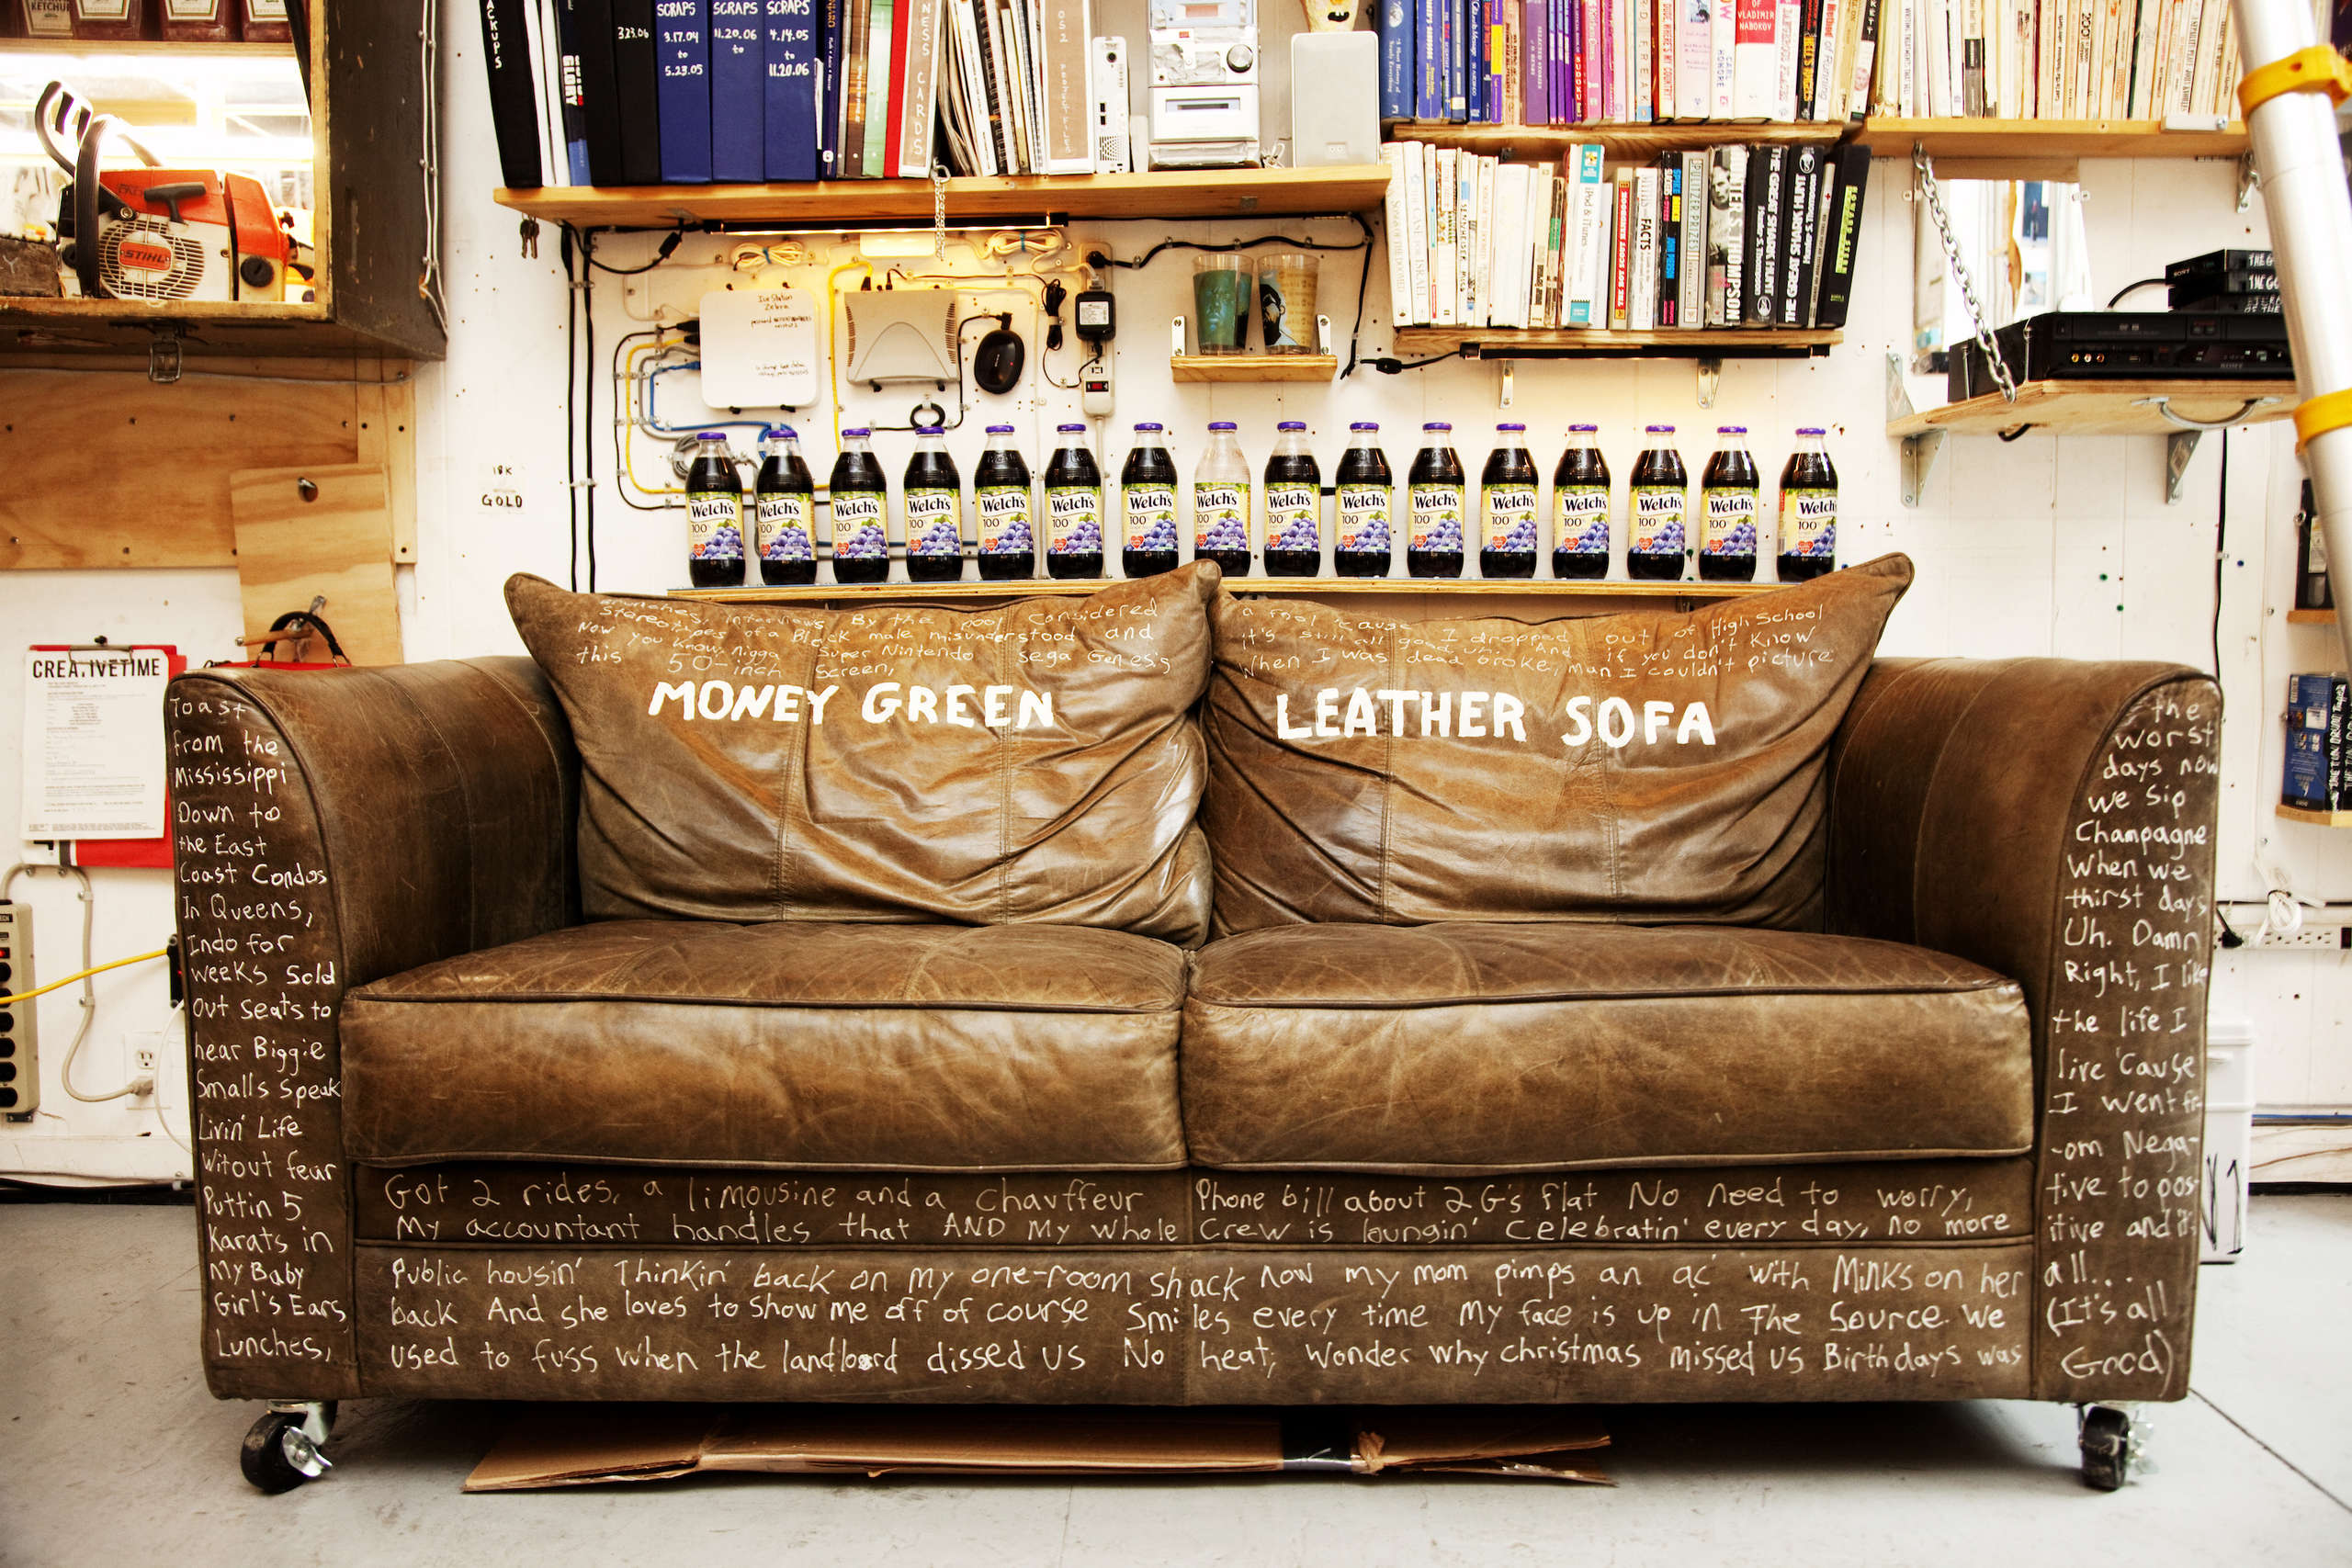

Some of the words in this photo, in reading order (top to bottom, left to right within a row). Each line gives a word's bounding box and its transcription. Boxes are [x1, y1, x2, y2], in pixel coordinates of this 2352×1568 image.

[656, 2, 696, 17] SCRAPS
[713, 1, 759, 16] SCRAPS
[766, 0, 810, 16] SCRAPS
[1739, 22, 1772, 31] NABOKOV
[677, 50, 689, 60] to
[784, 51, 796, 61] to
[1640, 219, 1651, 251] FACTS
[1726, 235, 1743, 321] THOMPSON
[481, 494, 523, 507] GOLD
[691, 501, 735, 518] Welch's
[835, 499, 878, 516] Welch's
[983, 494, 1026, 513] Welch's
[1129, 491, 1173, 511] Welch's
[1196, 491, 1238, 509] Welch's
[1342, 492, 1385, 510] Welch's
[1493, 493, 1536, 511] Welch's
[1565, 494, 1608, 513] Welch's
[1638, 494, 1682, 512] Welch's
[1710, 494, 1754, 513] Welch's
[869, 627, 913, 640] male
[1105, 623, 1154, 639] and
[882, 643, 974, 661] Nintendo
[1683, 639, 1738, 660] don't
[1748, 647, 1835, 673] picture
[170, 697, 246, 720] Toast
[648, 680, 840, 726] MONEY
[861, 682, 1055, 732] GREEN
[1276, 687, 1527, 742] LEATHER
[1560, 695, 1717, 749] SOFA
[174, 729, 223, 757] from
[243, 729, 278, 756] the
[175, 761, 287, 795] Mississippi
[2103, 753, 2162, 783] days
[177, 801, 234, 824] Down
[215, 833, 266, 856] East
[2075, 819, 2206, 861] Champagne
[180, 862, 237, 883] Coast
[252, 863, 327, 888] Condos
[2067, 849, 2138, 879] When
[187, 928, 237, 955] Indo
[246, 933, 294, 954] for
[2132, 919, 2199, 952] Damn
[287, 962, 335, 985] Sold
[2120, 1005, 2161, 1037] life
[195, 1032, 242, 1061] hear
[254, 1036, 325, 1077] Biggie
[197, 1068, 270, 1100] Smalls
[258, 1115, 302, 1139] Life
[287, 1150, 337, 1180] fear
[282, 1190, 302, 1221] 5
[384, 1174, 448, 1209] Got
[472, 1179, 501, 1207] 2
[689, 1177, 836, 1212] limousine
[856, 1178, 911, 1208] and
[1195, 1178, 1264, 1212] Phone
[1282, 1184, 1334, 1218] bill
[1344, 1185, 1426, 1213] about
[1629, 1180, 1679, 1210] No
[1707, 1177, 1785, 1208] need
[466, 1213, 640, 1241] accountant
[673, 1212, 809, 1244] handles
[944, 1213, 1006, 1238] AND
[1705, 1218, 1786, 1239] every
[1946, 1212, 2011, 1235] more
[2126, 1208, 2171, 1239] and
[208, 1224, 288, 1254] Karats
[250, 1261, 304, 1290] Baby
[392, 1257, 468, 1289] Public
[752, 1262, 835, 1294] back
[971, 1265, 1131, 1295] one-room
[1414, 1264, 1468, 1285] mom
[1495, 1258, 1576, 1299] pimps
[1981, 1262, 2023, 1298] her
[214, 1289, 281, 1316] Girl's
[488, 1296, 545, 1329] And
[626, 1290, 687, 1316] loves
[987, 1298, 1089, 1324] course
[1362, 1302, 1429, 1329] time
[1519, 1299, 1572, 1327] face
[1740, 1303, 1802, 1335] The
[216, 1327, 331, 1361] Lunches,
[391, 1337, 459, 1370] used
[532, 1339, 598, 1374] fuss
[616, 1336, 698, 1373] when
[927, 1341, 1025, 1375] dissed
[1670, 1341, 1755, 1376] missed
[1824, 1341, 1962, 1378] Birthdays
